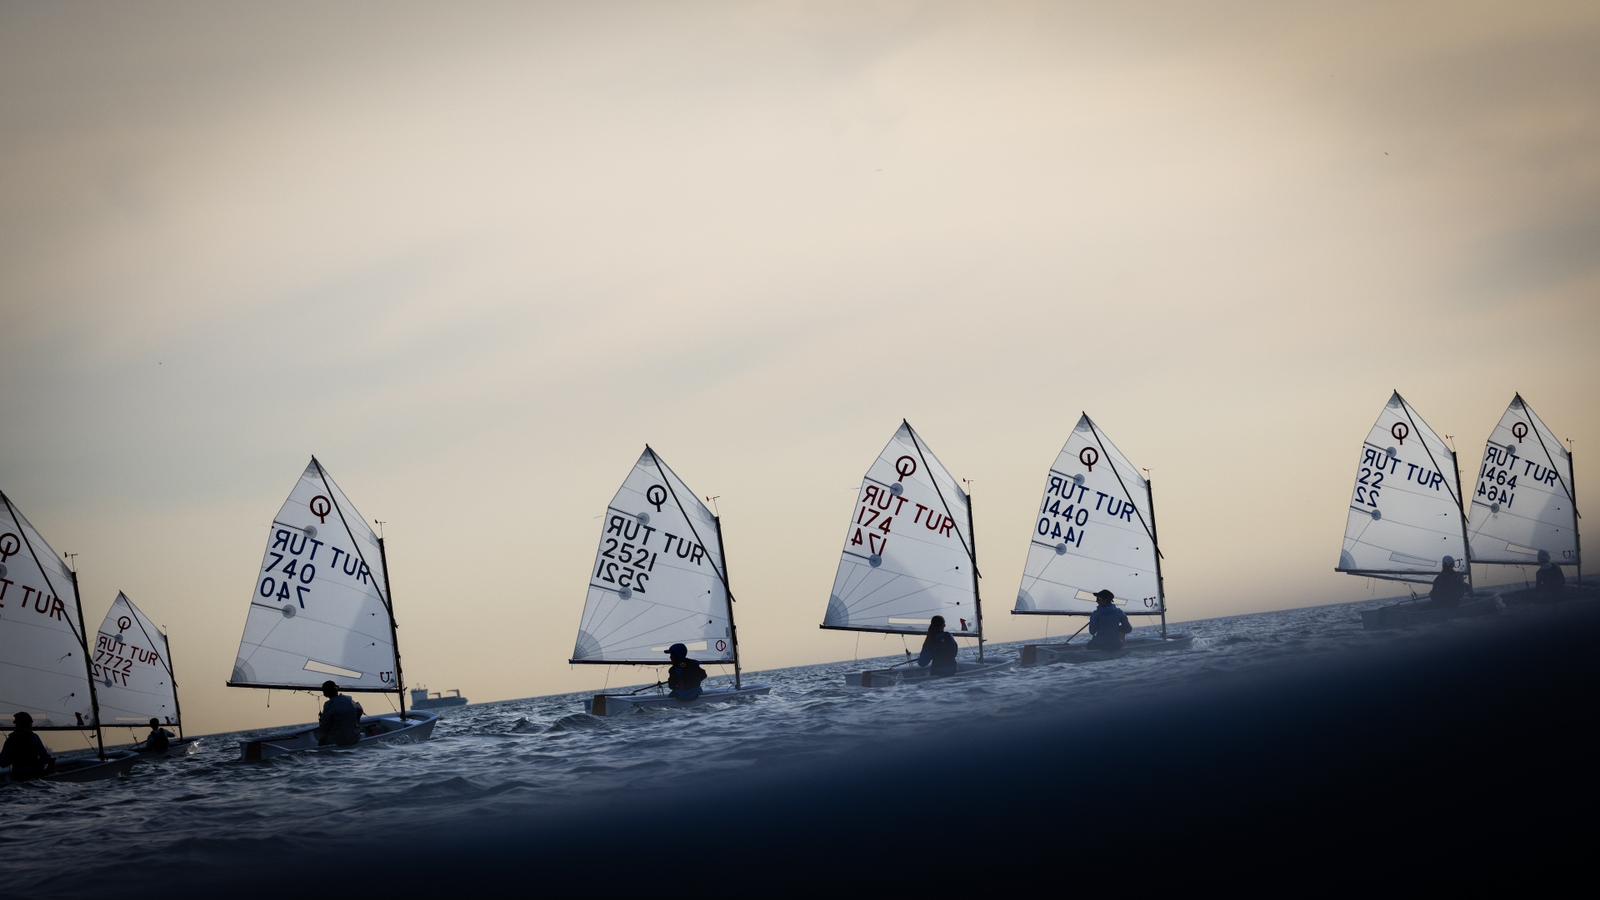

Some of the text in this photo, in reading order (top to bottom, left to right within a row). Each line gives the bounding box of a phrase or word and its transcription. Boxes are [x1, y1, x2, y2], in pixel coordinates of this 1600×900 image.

[1359, 468, 1384, 489] 22
[1407, 463, 1444, 491] TUR
[1481, 464, 1517, 490] 1464
[1524, 460, 1558, 487] TUR
[857, 506, 892, 534] 174
[914, 504, 955, 538] TUR
[1042, 496, 1089, 527] 1440
[1095, 491, 1134, 522] TUR
[602, 538, 657, 572] 2521
[663, 533, 704, 566] TUR
[264, 552, 315, 584] 740
[331, 547, 370, 584] TUR
[22, 585, 64, 621] TUR
[96, 650, 132, 672] 7772
[131, 646, 158, 666] TUR
